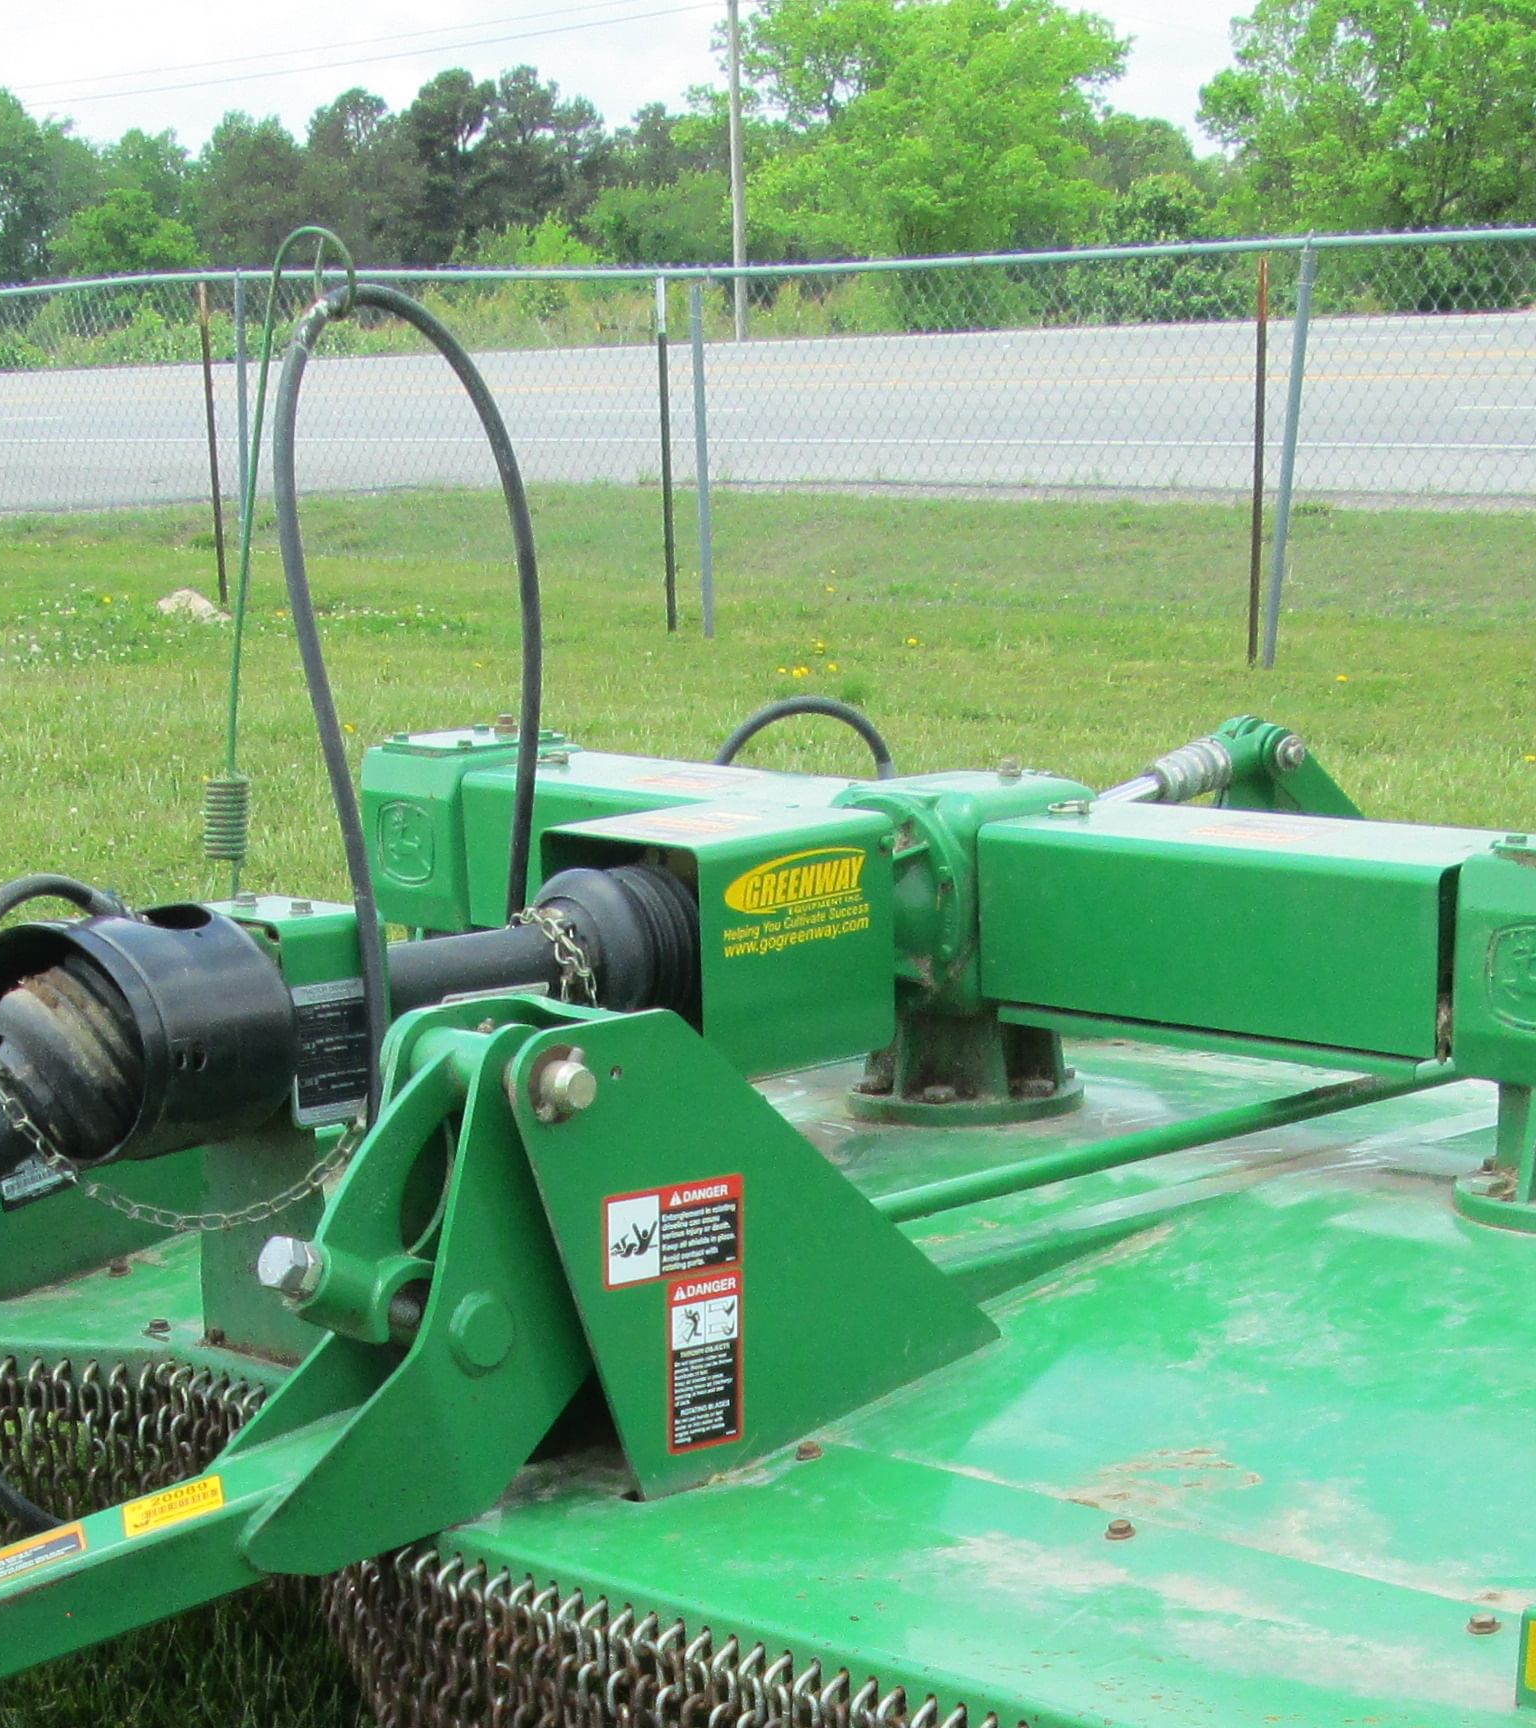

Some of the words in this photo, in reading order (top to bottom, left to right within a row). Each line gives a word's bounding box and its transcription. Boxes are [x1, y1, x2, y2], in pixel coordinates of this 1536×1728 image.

[744, 854, 865, 911] GREENWAY
[788, 897, 843, 915] EQUIPMENT
[723, 925, 760, 941] Helping
[763, 920, 781, 933] You
[783, 911, 826, 929] Cultivate
[828, 903, 869, 920] Success
[724, 916, 869, 958] www.gogreenway.com
[683, 1184, 728, 1203] DANGER
[687, 1277, 736, 1298] DANGER
[151, 1482, 208, 1506] 20089
